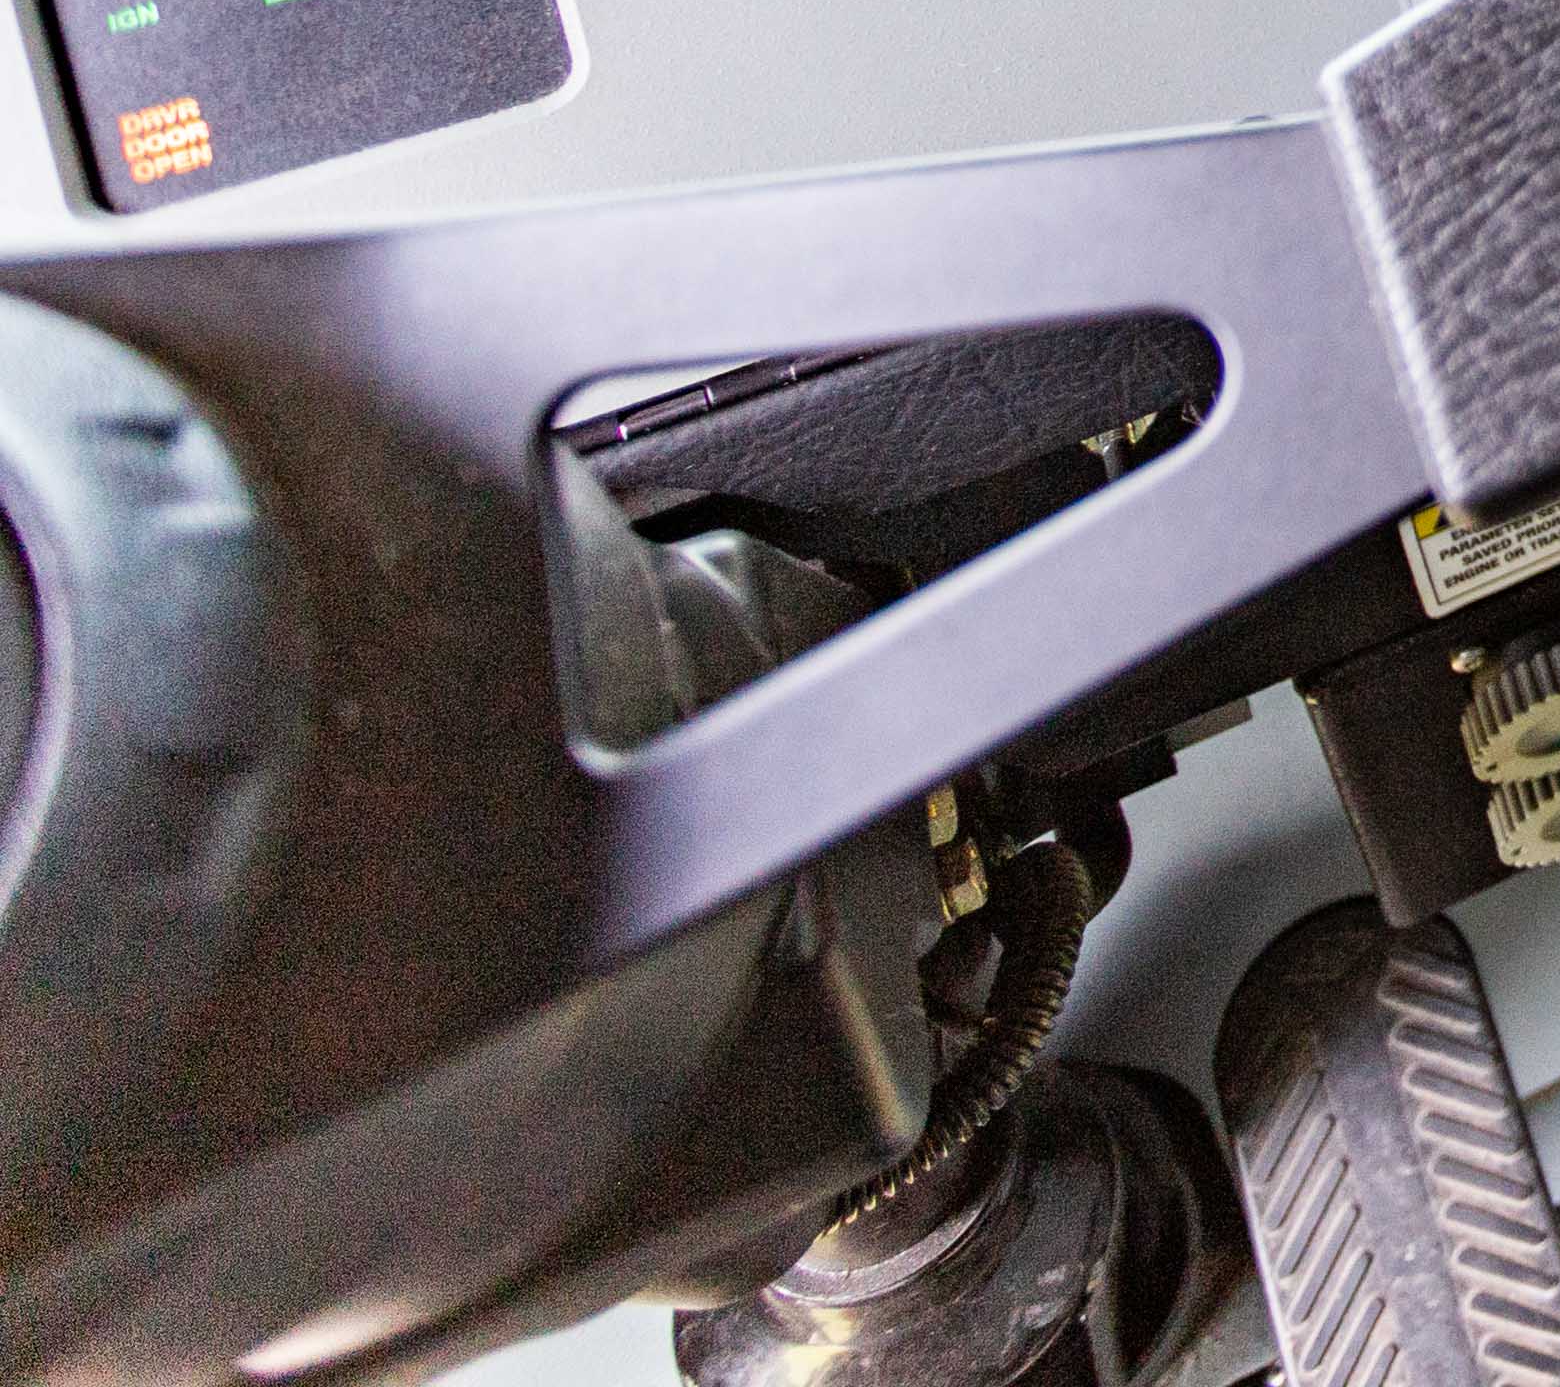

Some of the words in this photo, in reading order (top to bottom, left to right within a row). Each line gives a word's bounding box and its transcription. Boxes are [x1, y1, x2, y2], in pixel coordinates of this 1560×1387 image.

[107, 0, 160, 35] IGN
[118, 97, 200, 137] DRVR
[122, 119, 210, 162] DOOR
[129, 143, 213, 184] OPEN
[1439, 513, 1534, 561] PARAMETER
[1462, 537, 1512, 566] SAVED
[1443, 559, 1500, 589] ENGINE
[1504, 548, 1526, 564] OR
